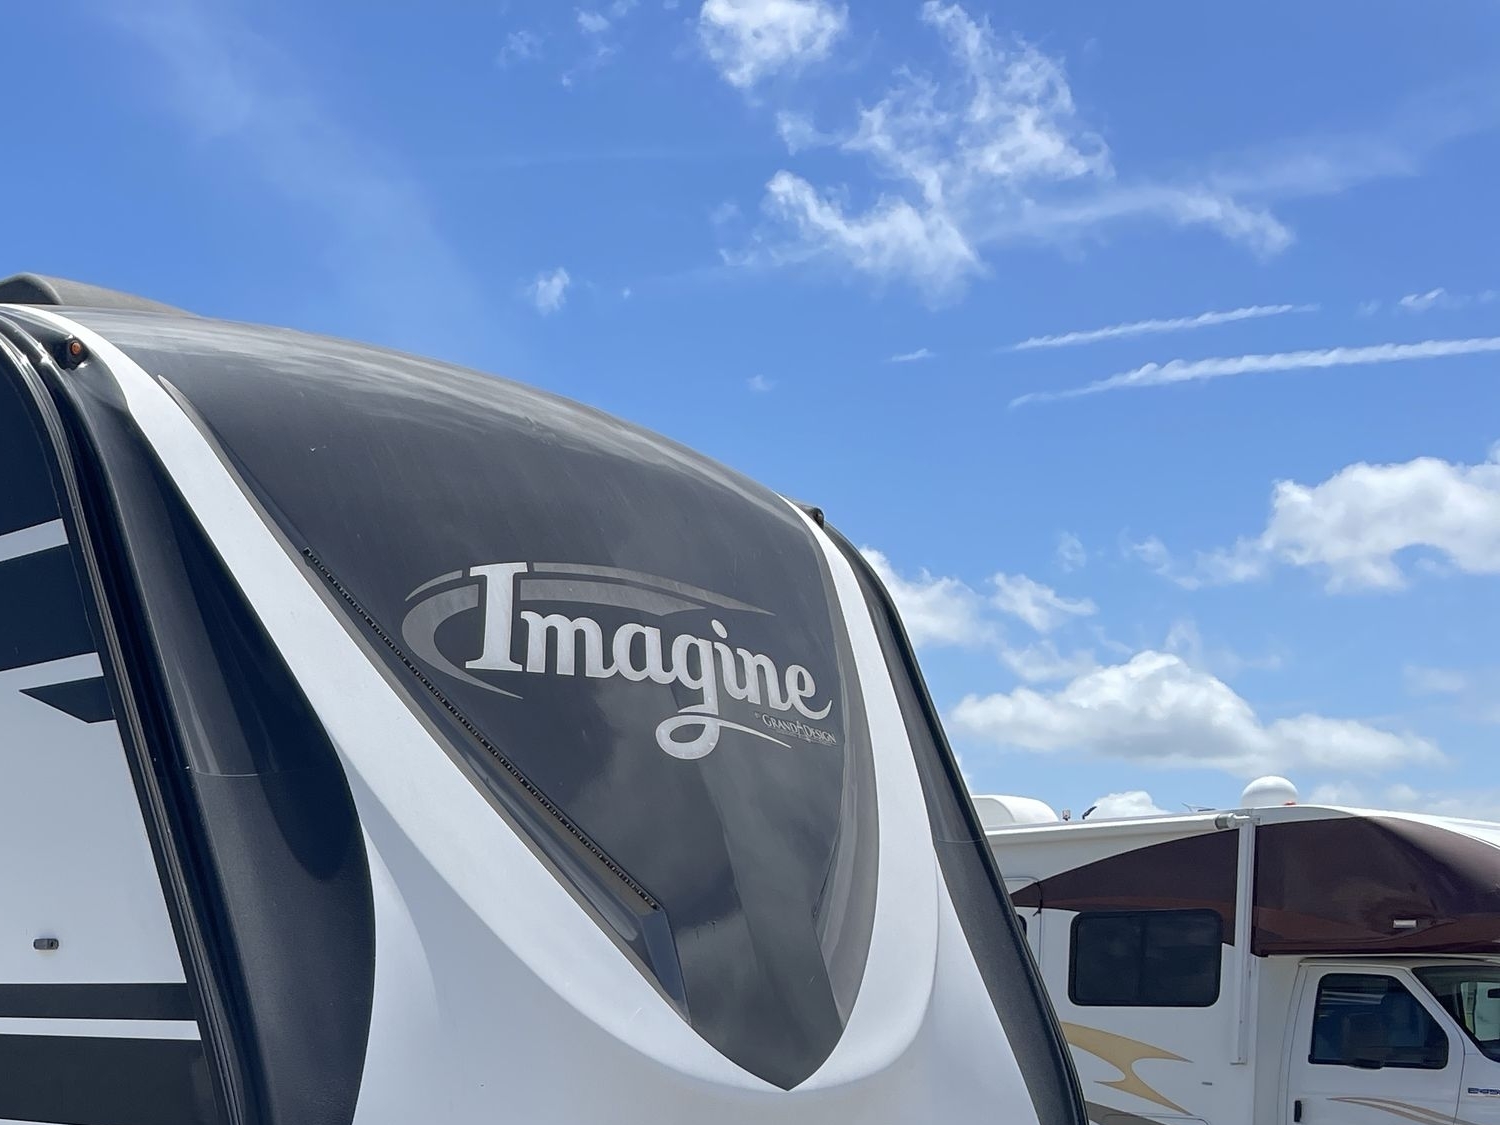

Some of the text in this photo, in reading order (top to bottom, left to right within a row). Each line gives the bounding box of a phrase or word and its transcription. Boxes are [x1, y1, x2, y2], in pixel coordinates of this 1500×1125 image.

[465, 561, 832, 760] Imagine
[762, 714, 799, 734] GRAND
[802, 724, 837, 744] DESIGN
[1467, 1086, 1500, 1096] E45
